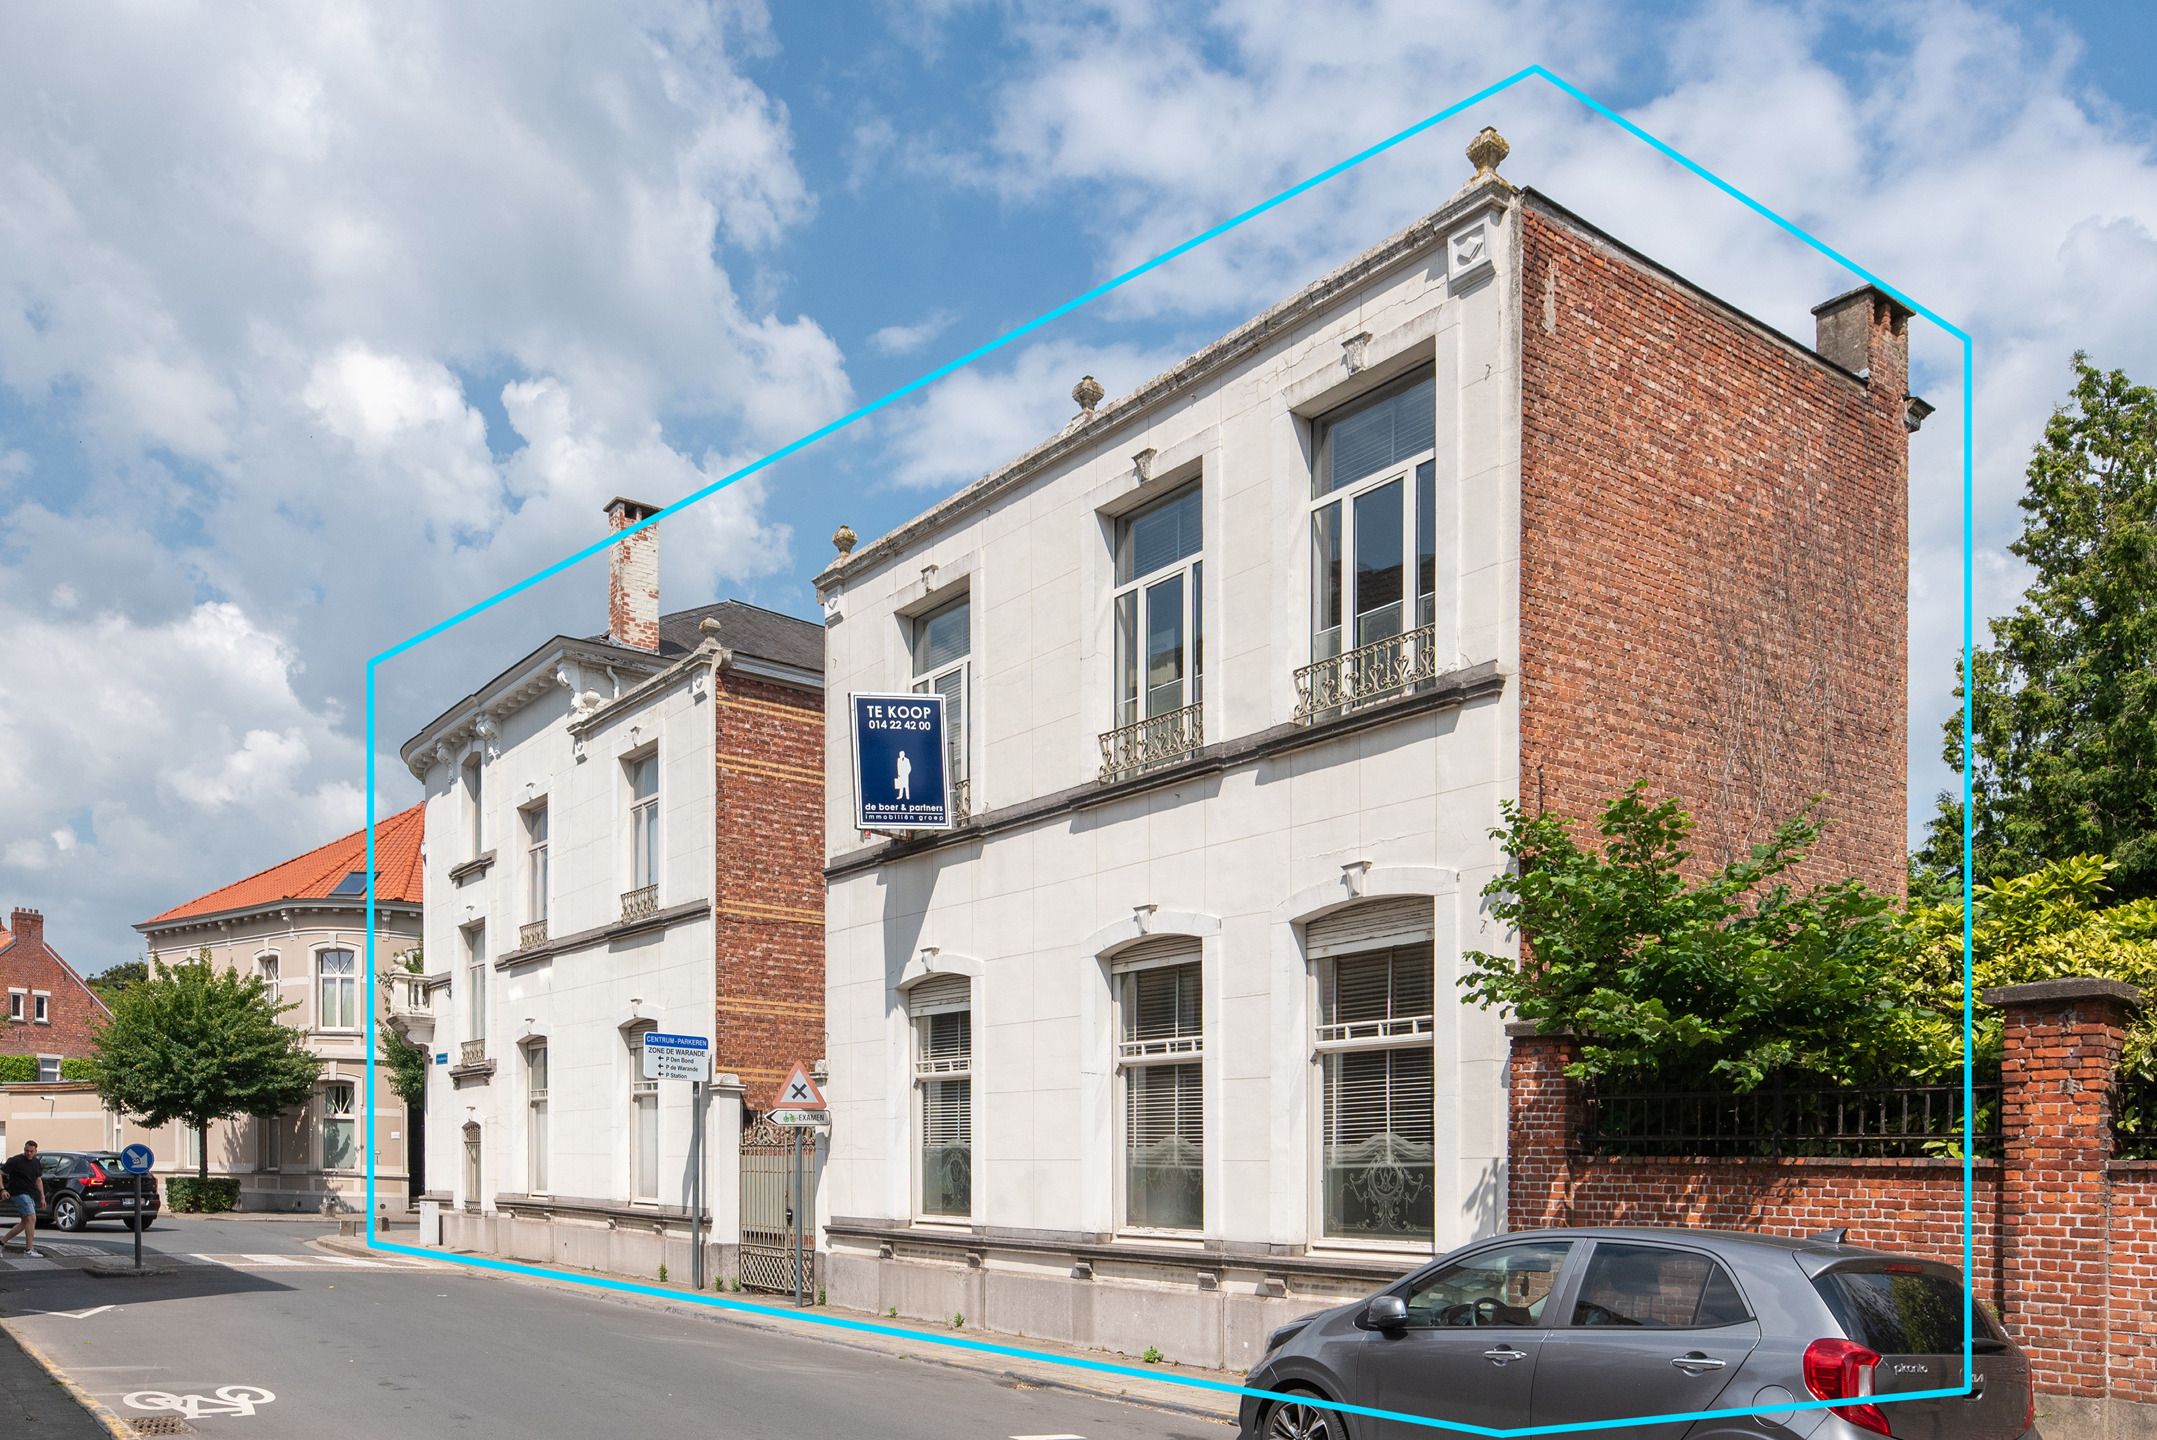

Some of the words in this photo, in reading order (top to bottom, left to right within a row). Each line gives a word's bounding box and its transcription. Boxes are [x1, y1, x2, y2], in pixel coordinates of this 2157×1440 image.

[866, 705, 882, 718] TE
[888, 705, 931, 719] KOOP
[868, 720, 887, 729] 014
[890, 720, 902, 729] 22
[904, 721, 916, 730] 42
[918, 721, 931, 730] 00
[865, 803, 876, 811] de
[879, 803, 898, 811] boer
[909, 804, 943, 813] partners
[675, 1049, 706, 1057] WARANDE
[1894, 1363, 1928, 1375] picanto
